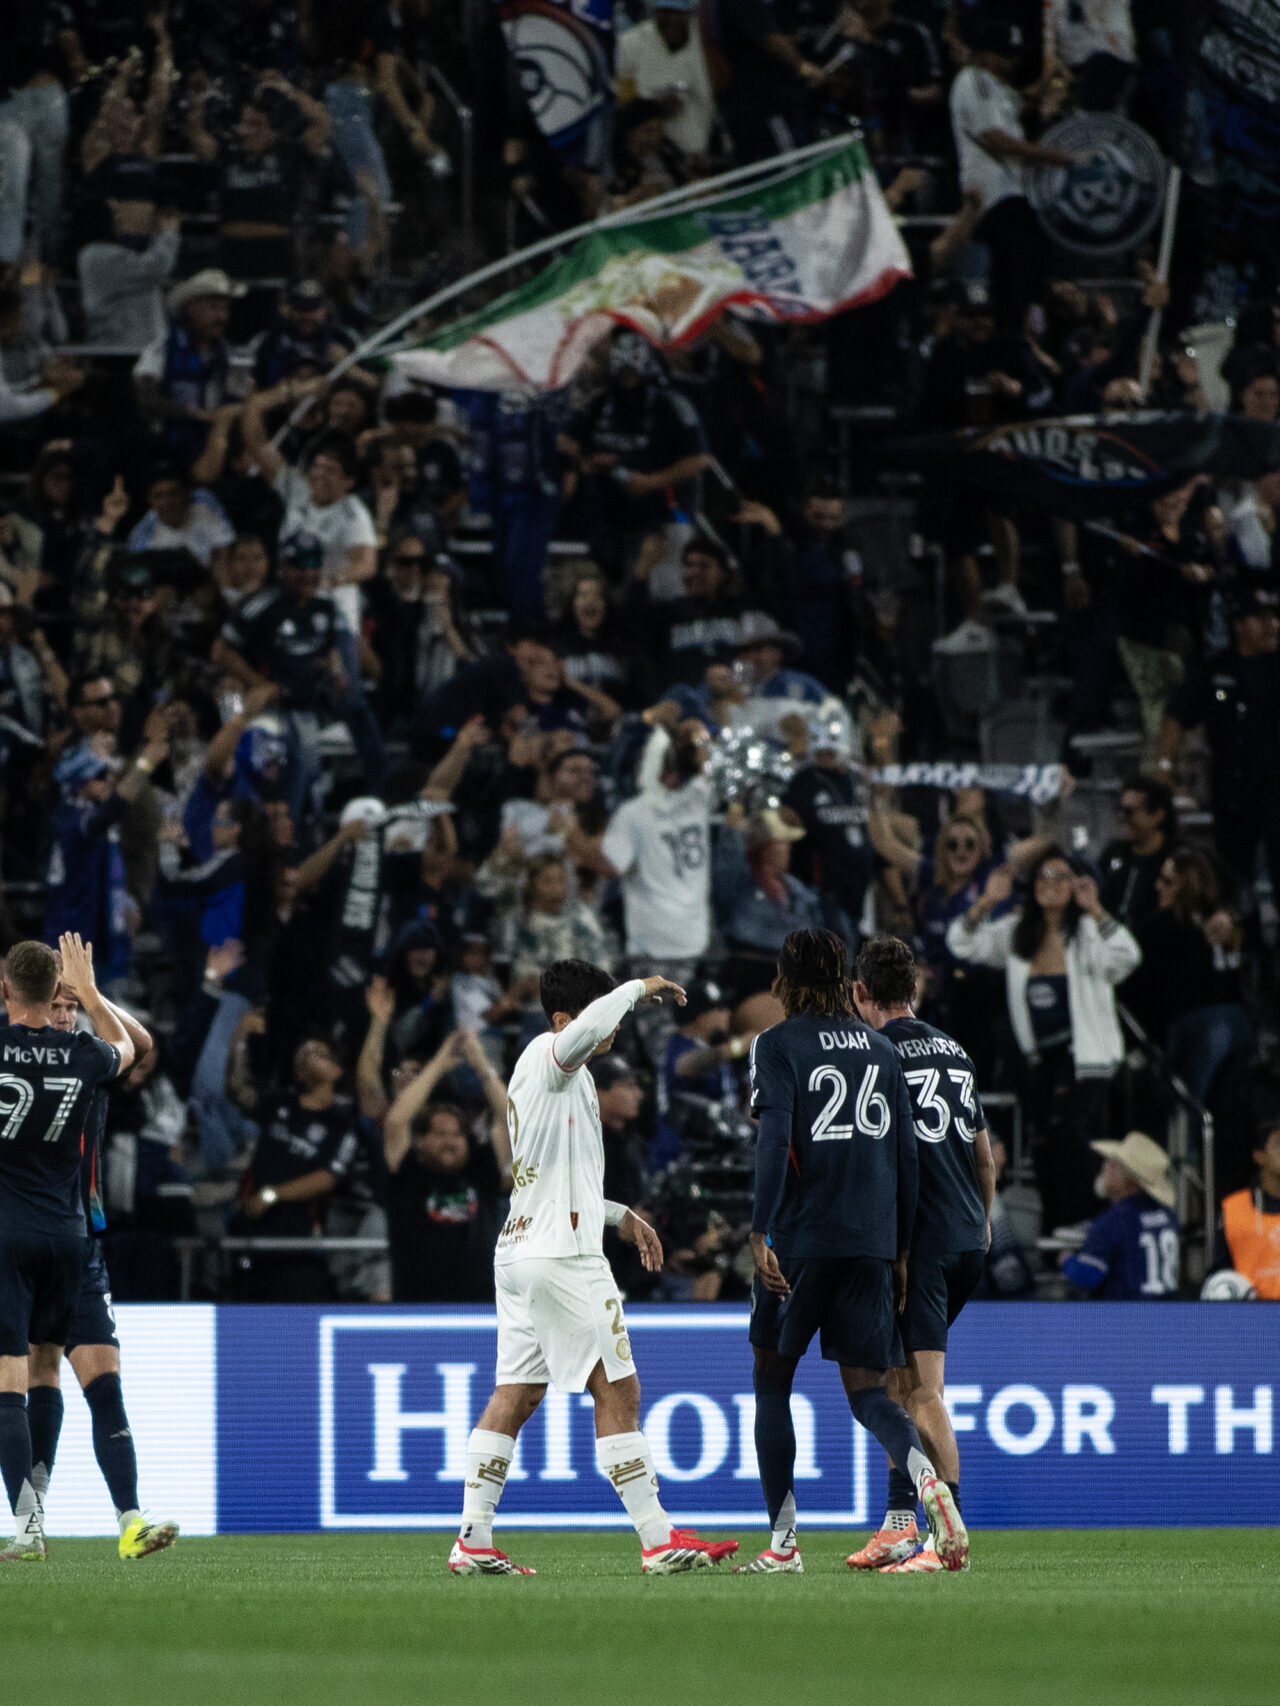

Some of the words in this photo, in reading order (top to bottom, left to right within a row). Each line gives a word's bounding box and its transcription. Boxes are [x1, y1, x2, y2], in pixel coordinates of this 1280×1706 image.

[3, 1045, 72, 1065] McVEY
[819, 1031, 871, 1051] DUAH
[808, 1064, 892, 1142] 26
[903, 1067, 977, 1143] 33
[366, 1363, 824, 1482] Hlon
[942, 1384, 1117, 1456] FOR
[1150, 1384, 1273, 1455] TH
